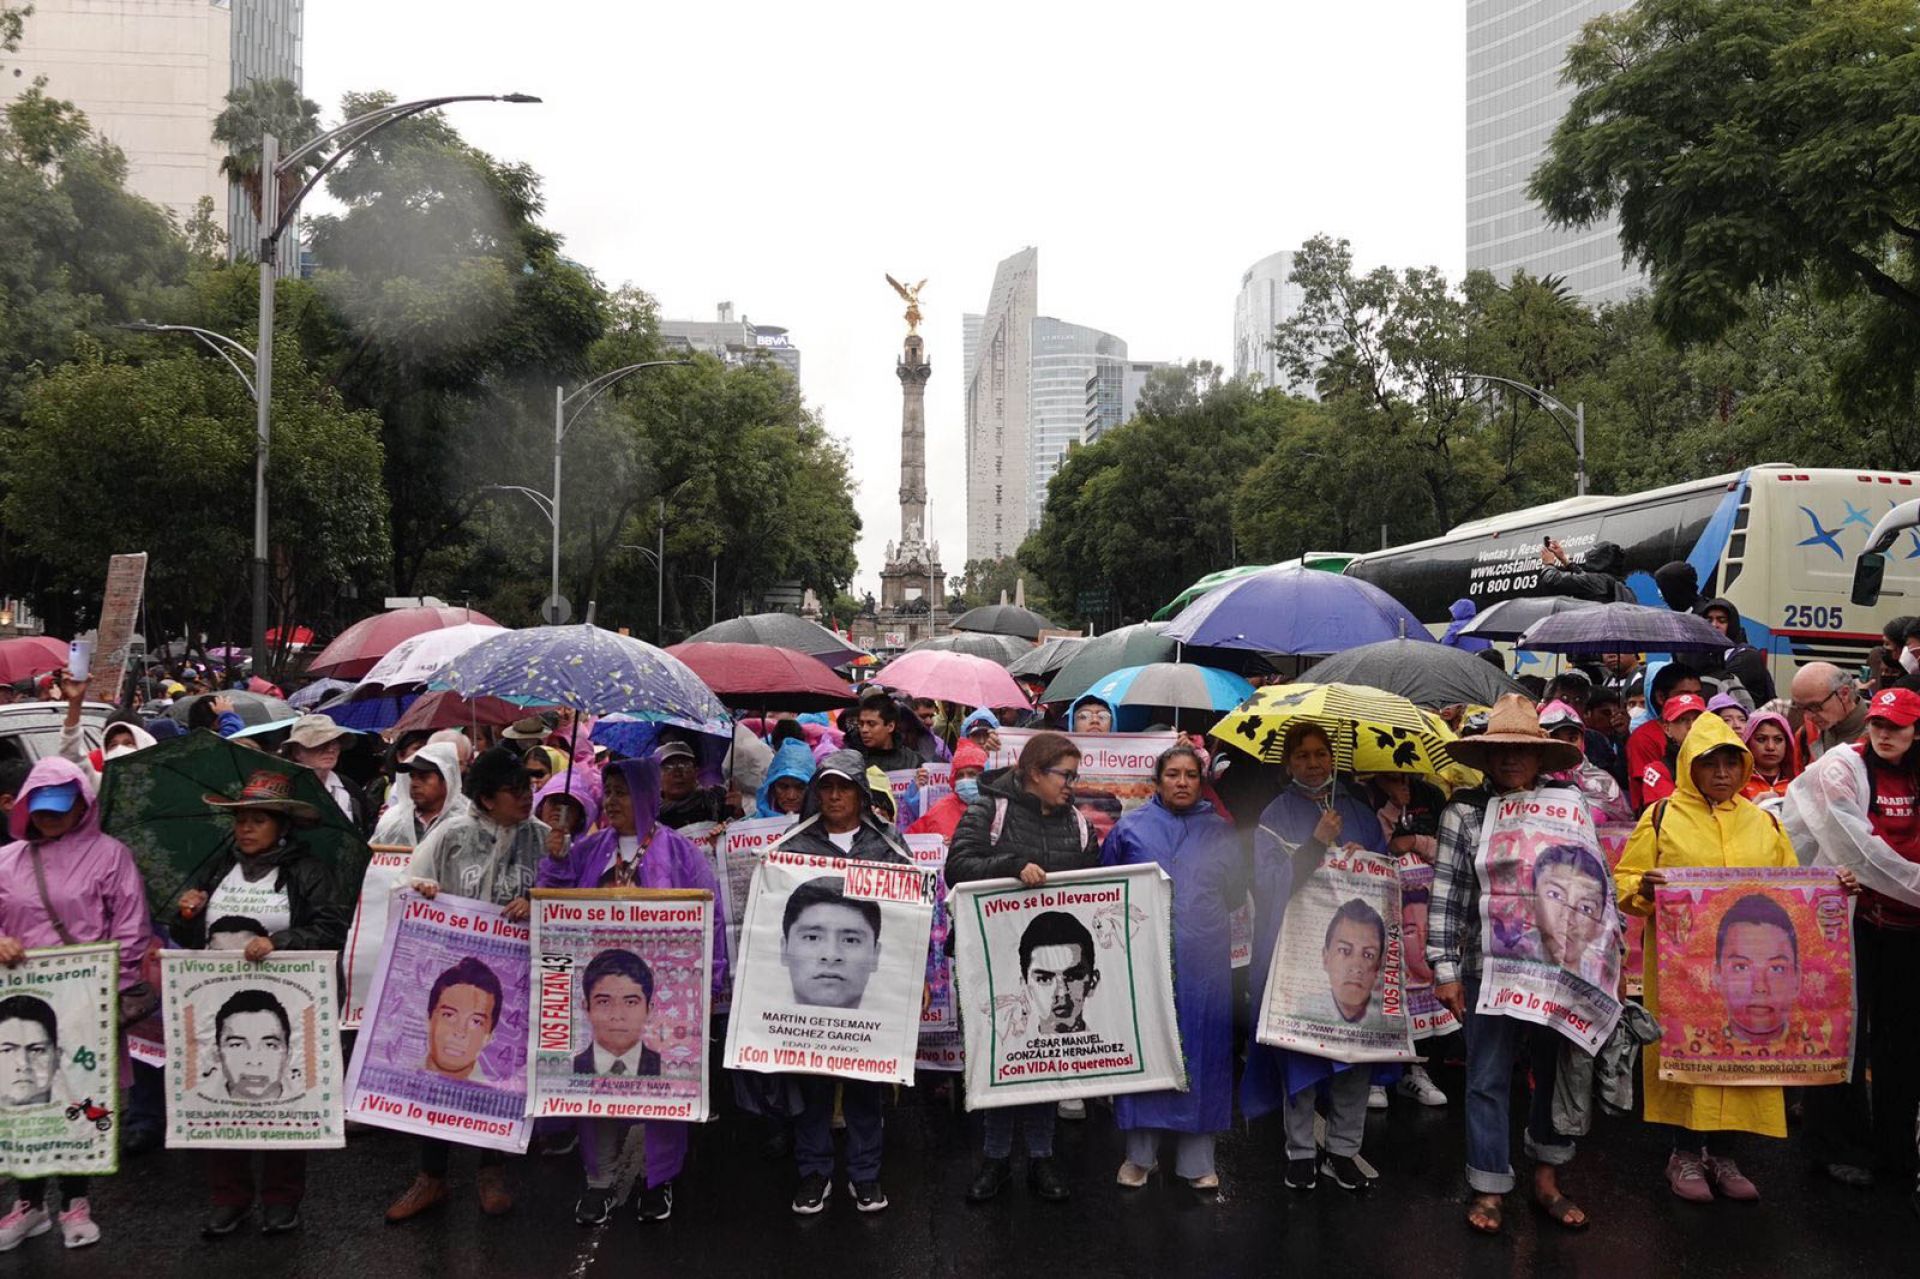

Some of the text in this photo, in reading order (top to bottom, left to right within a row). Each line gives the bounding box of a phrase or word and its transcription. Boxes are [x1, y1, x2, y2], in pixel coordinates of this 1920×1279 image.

[1478, 533, 1596, 562] Ventas y Reseciones
[1469, 575, 1538, 595] 01 800 003
[1784, 604, 1843, 629] 2505
[1101, 750, 1158, 768] llevaro
[929, 773, 951, 786] ¡Viv
[1498, 801, 1541, 820] ¡Vivo
[1546, 804, 1567, 818] se
[727, 832, 762, 852] ¡Vivo
[402, 857, 411, 867] s
[808, 855, 828, 869] se
[831, 858, 847, 870] lo
[913, 848, 942, 862] ron!
[1328, 857, 1348, 871] se
[1352, 859, 1364, 875] lo
[845, 868, 937, 905] NOS FALTAN 43
[985, 888, 1120, 918] ¡Vivo se lo llevaron!
[404, 902, 446, 924] ¡Vivo
[449, 915, 469, 929] se
[473, 914, 489, 933] lo
[492, 919, 530, 941] lleva
[543, 904, 703, 923] ¡Vivo se lo llevaron!
[8, 965, 97, 987] lo llevaron!
[180, 960, 315, 974] ¡Vivo se lo llevaron!
[1384, 924, 1400, 1014] NOS FALTAN 43
[541, 952, 573, 1050] NOS FALTAN 43!
[1526, 992, 1540, 1009] lo
[762, 1011, 882, 1031] MARTÍN GETSEMANY
[1413, 1017, 1426, 1031] lo
[768, 1023, 872, 1043] SÁNCHEZ GARCÍA
[1026, 1033, 1104, 1049] CÉSAR MANUEL
[782, 1040, 811, 1050] EDAD
[1006, 1043, 1125, 1061] GONZÁLEZ HERNÁNDEZ
[72, 1045, 97, 1071] 43
[738, 1046, 898, 1075] ¡Con VIDA lo queremos!
[999, 1054, 1133, 1080] ¡Con VIDA lo queremos!
[1664, 1061, 1712, 1073] CHRISTIAN
[1717, 1063, 1756, 1073] ALFONSO
[360, 1094, 514, 1137] ¡Vivo lo queremos!
[542, 1097, 692, 1117] ¡Vivo lo queremos!
[186, 1127, 320, 1141] ¡Con VIDA lo queremos!
[26, 1138, 94, 1155] queremos!
